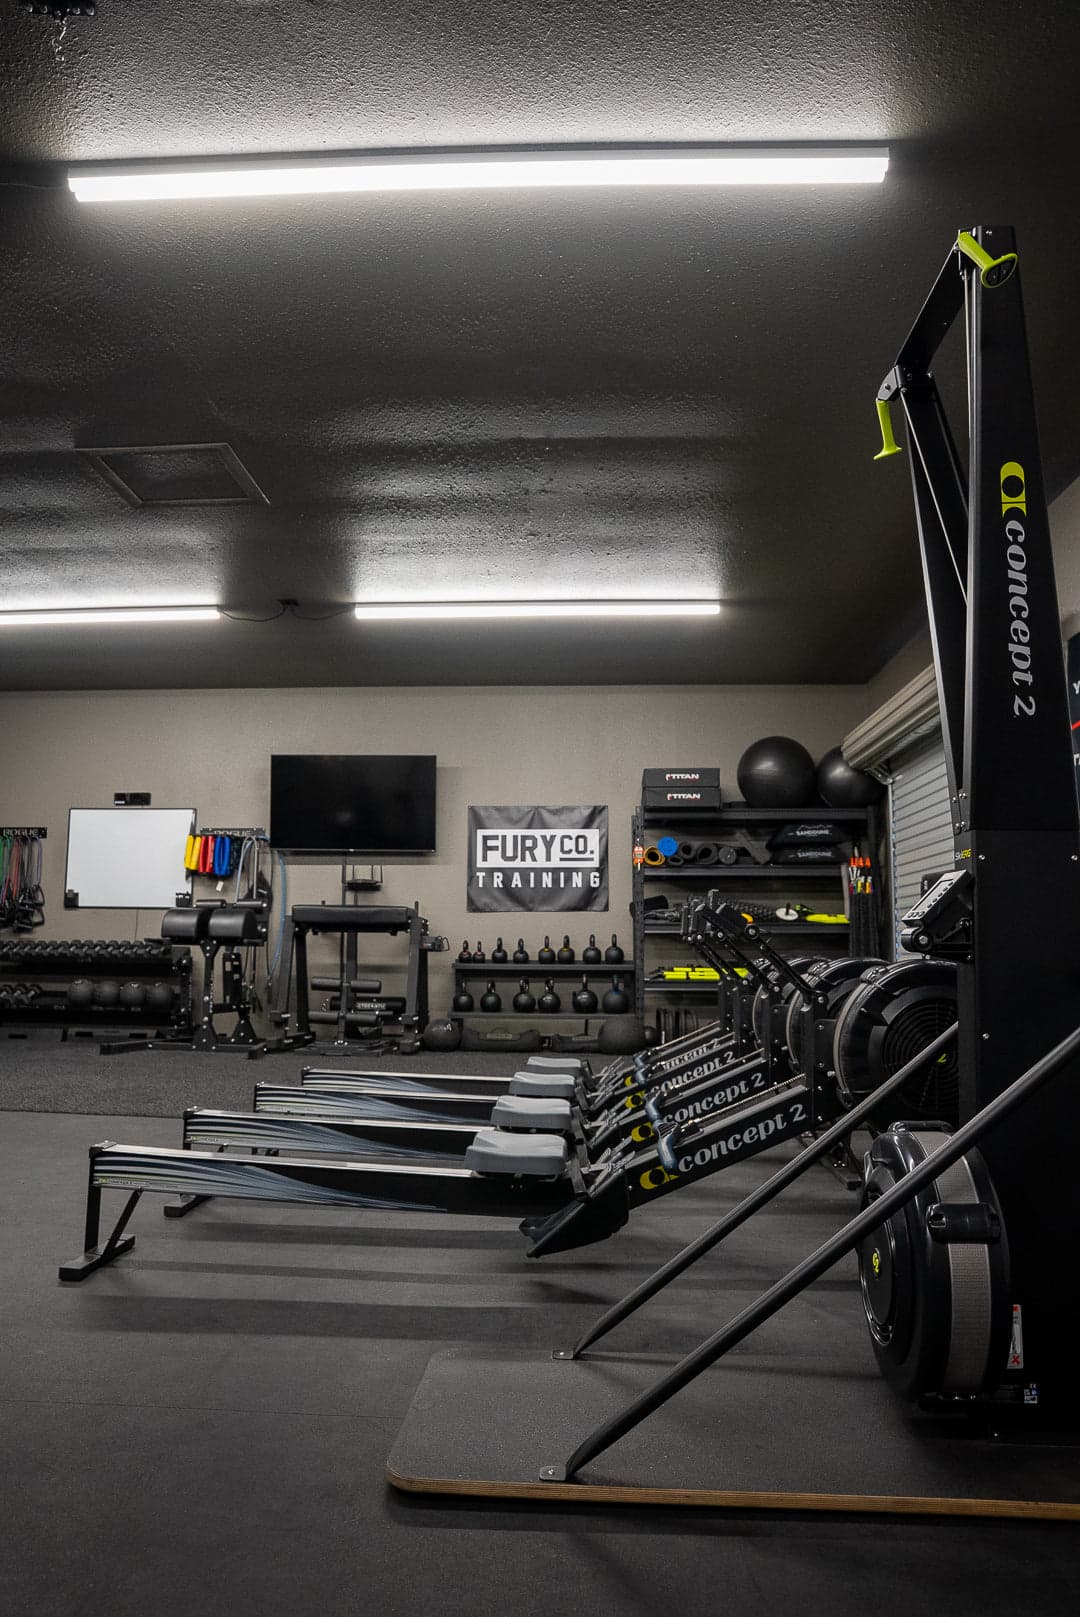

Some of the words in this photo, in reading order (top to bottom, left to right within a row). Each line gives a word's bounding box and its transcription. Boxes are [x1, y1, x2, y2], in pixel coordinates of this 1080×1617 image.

[1006, 520, 1033, 686] concept
[1013, 695, 1036, 717] 2
[481, 834, 557, 862] FURY
[559, 834, 595, 855] CO.
[476, 871, 600, 888] TRAINING
[751, 1072, 766, 1088] 2
[678, 1112, 788, 1173] concept
[789, 1103, 807, 1122] 2
